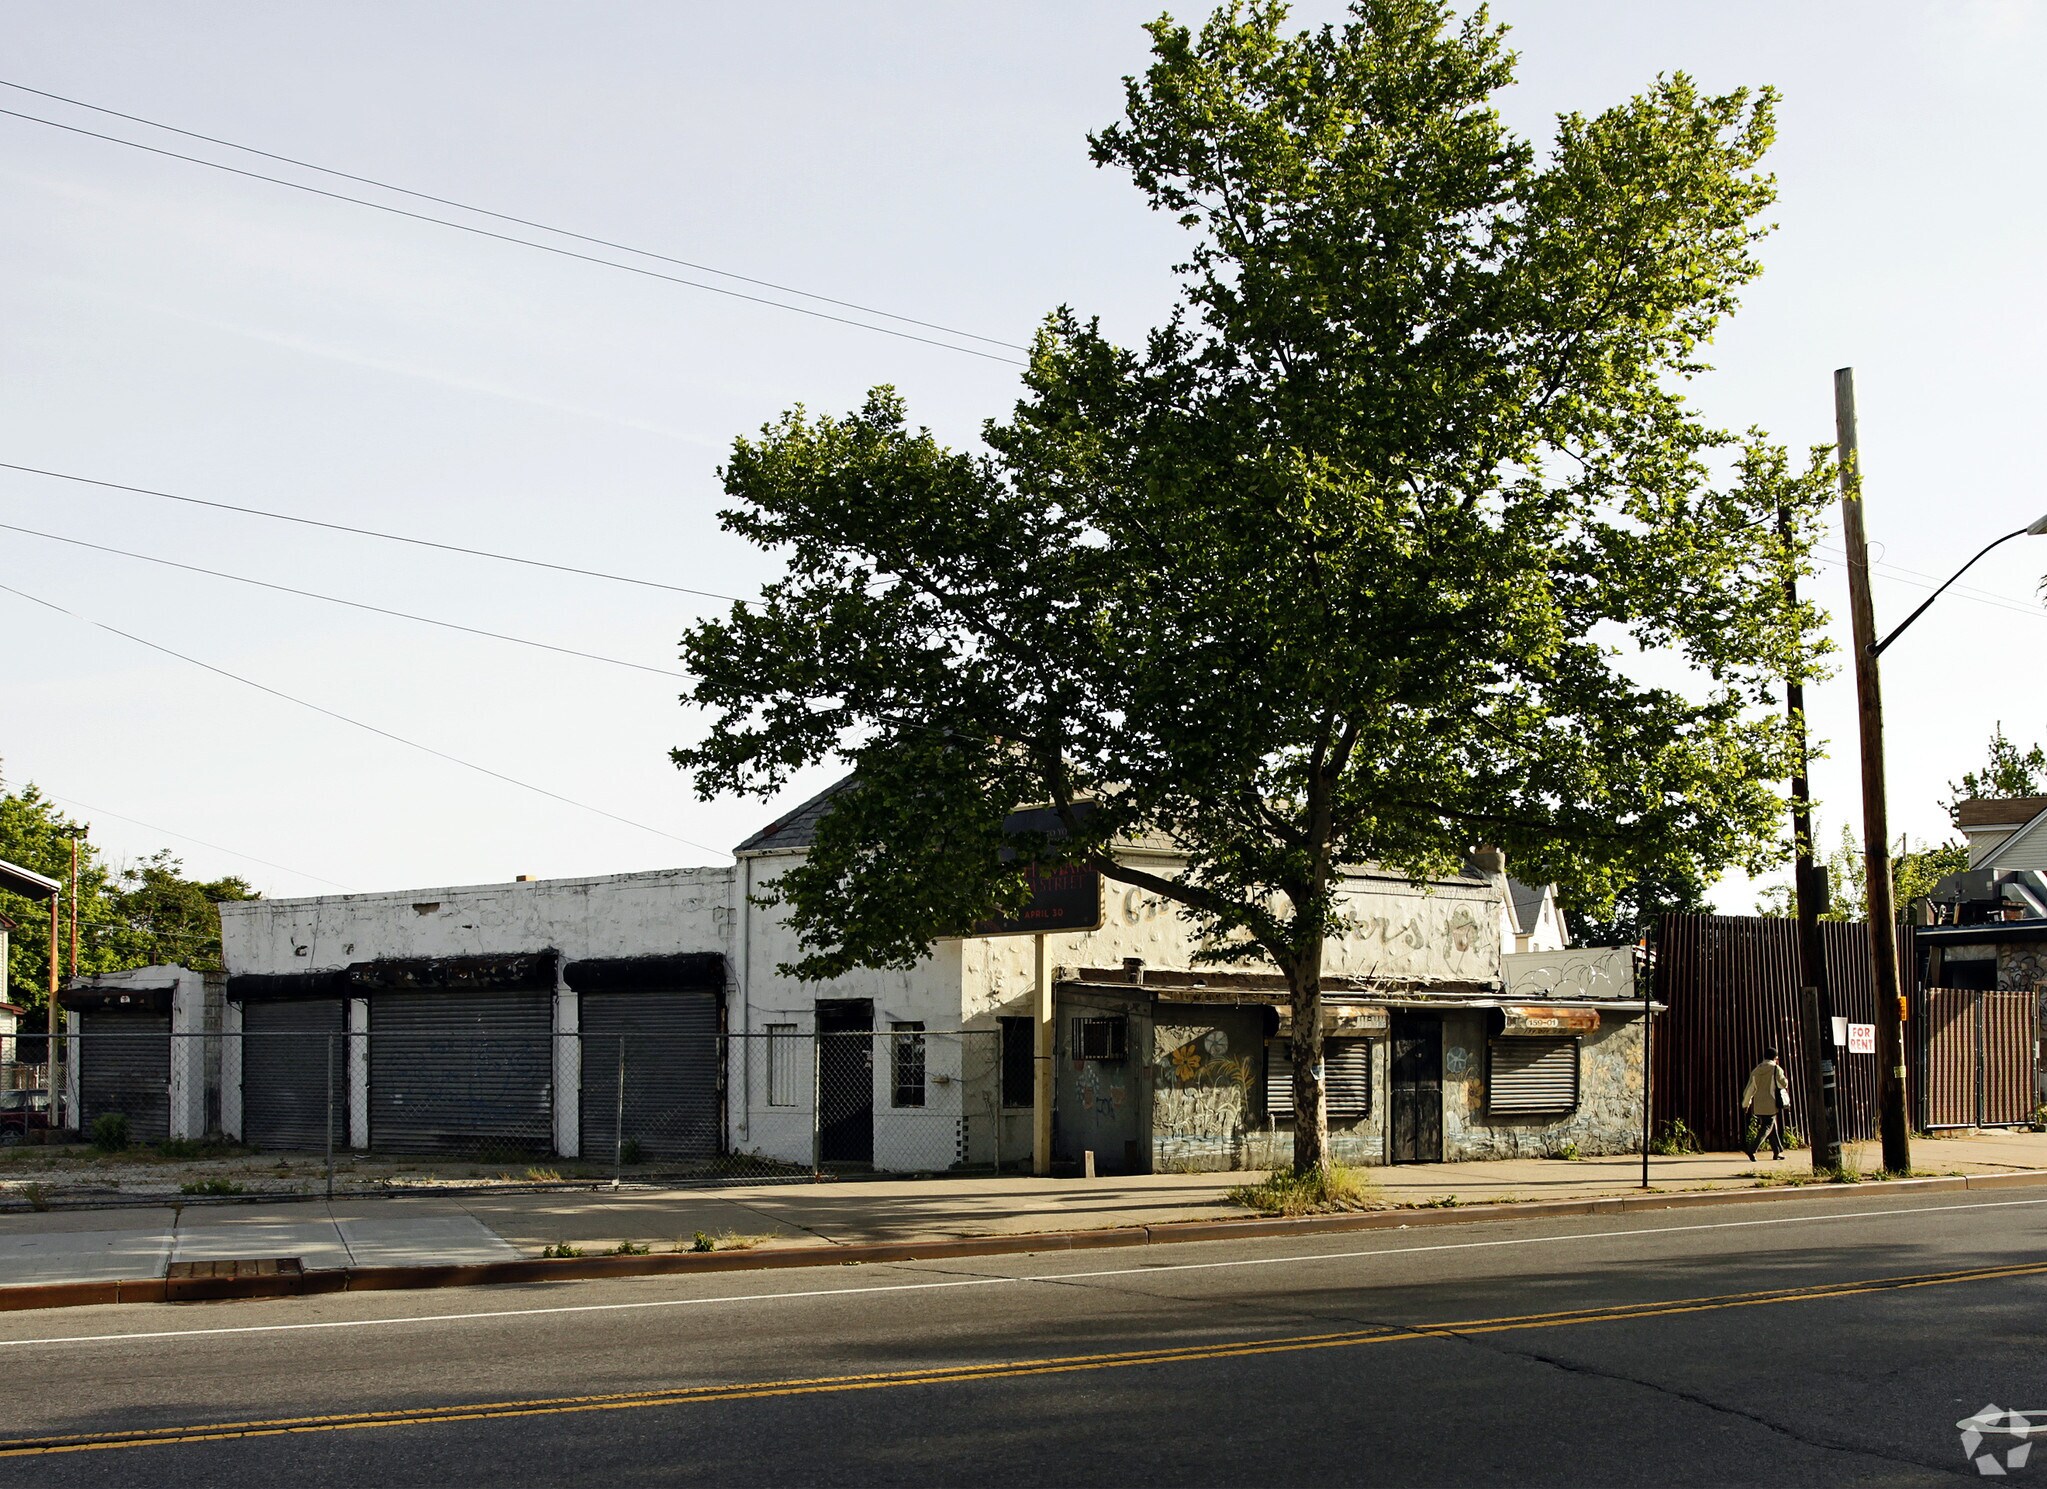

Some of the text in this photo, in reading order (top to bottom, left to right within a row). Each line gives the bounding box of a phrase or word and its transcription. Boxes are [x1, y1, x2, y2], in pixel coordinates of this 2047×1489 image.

[1040, 875, 1084, 891] STREET
[1024, 908, 1064, 919] APRIL 30
[1529, 1019, 1556, 1027] 159-01
[1852, 1027, 1870, 1037] FOR
[1850, 1039, 1872, 1050] RENT
